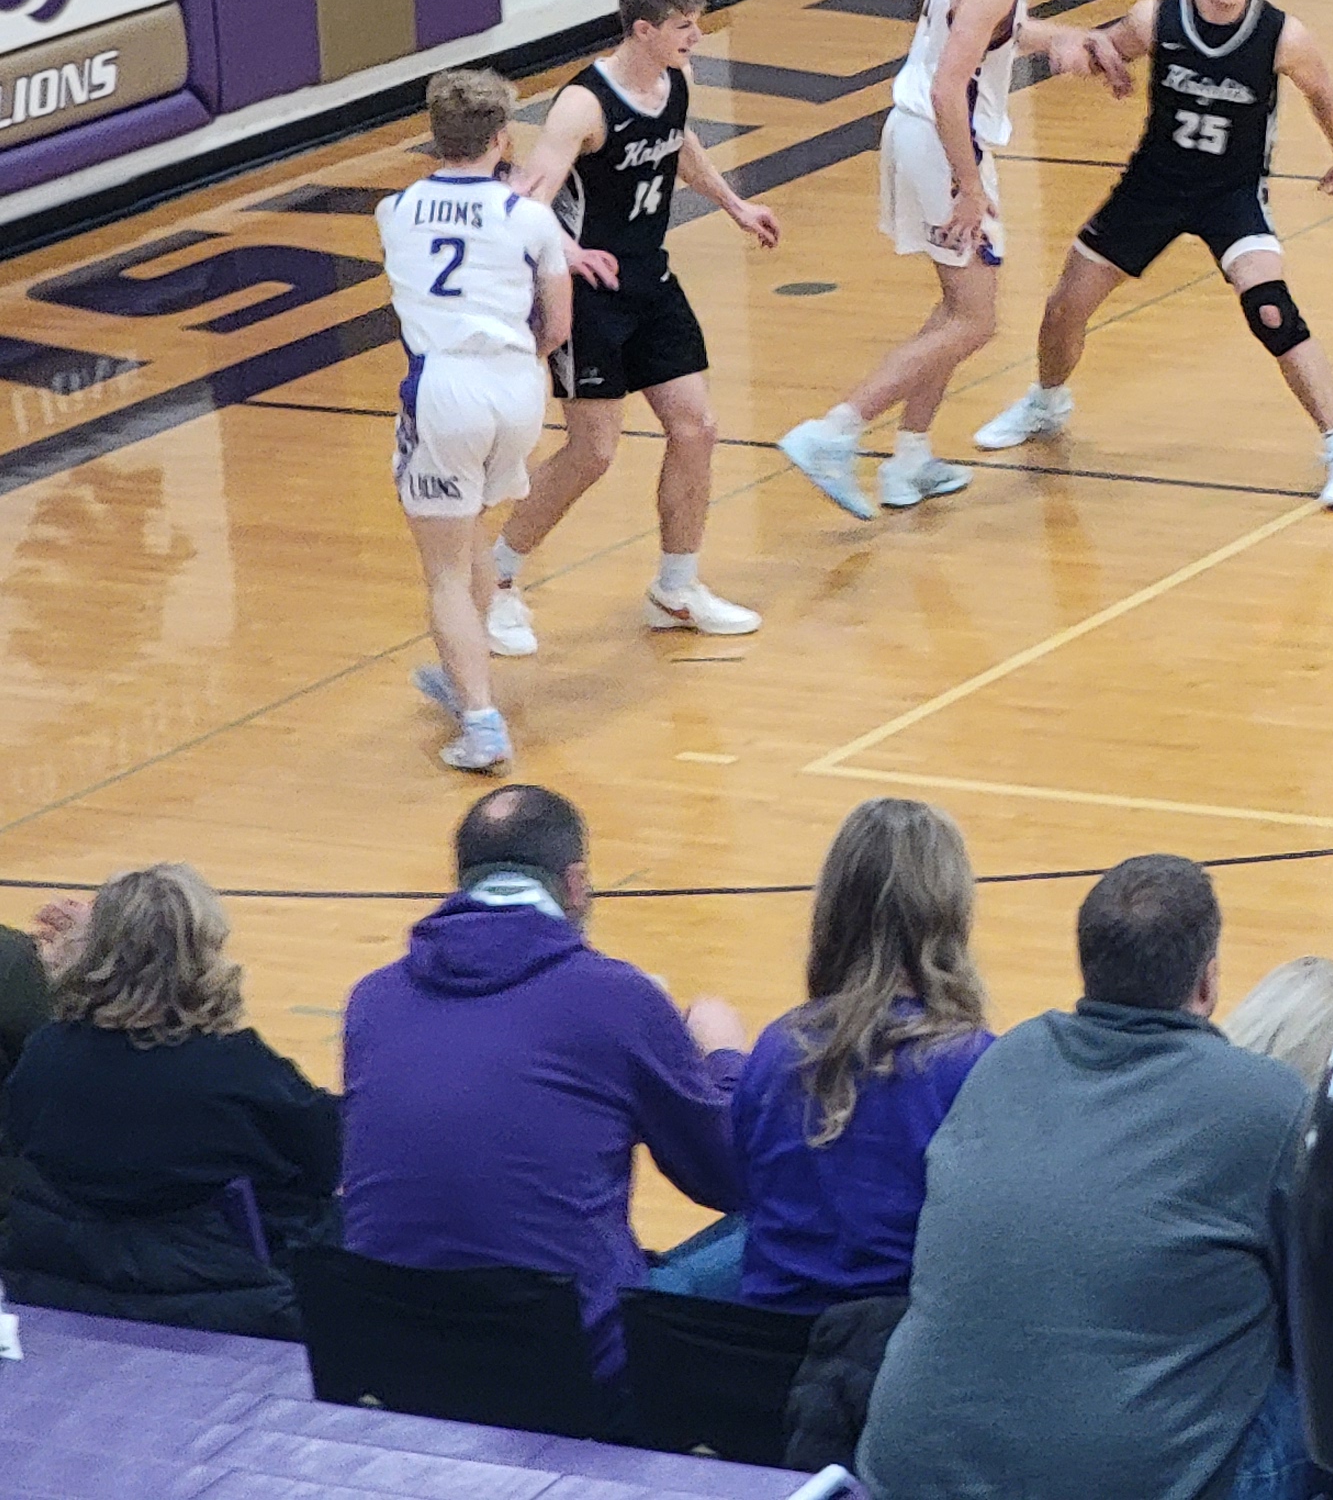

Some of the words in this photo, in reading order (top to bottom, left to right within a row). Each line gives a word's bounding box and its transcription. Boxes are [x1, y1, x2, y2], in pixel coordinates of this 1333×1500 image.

[1171, 108, 1232, 156] 25
[413, 199, 484, 229] LIONS
[429, 237, 467, 297] 2
[408, 473, 461, 501] LIONS
